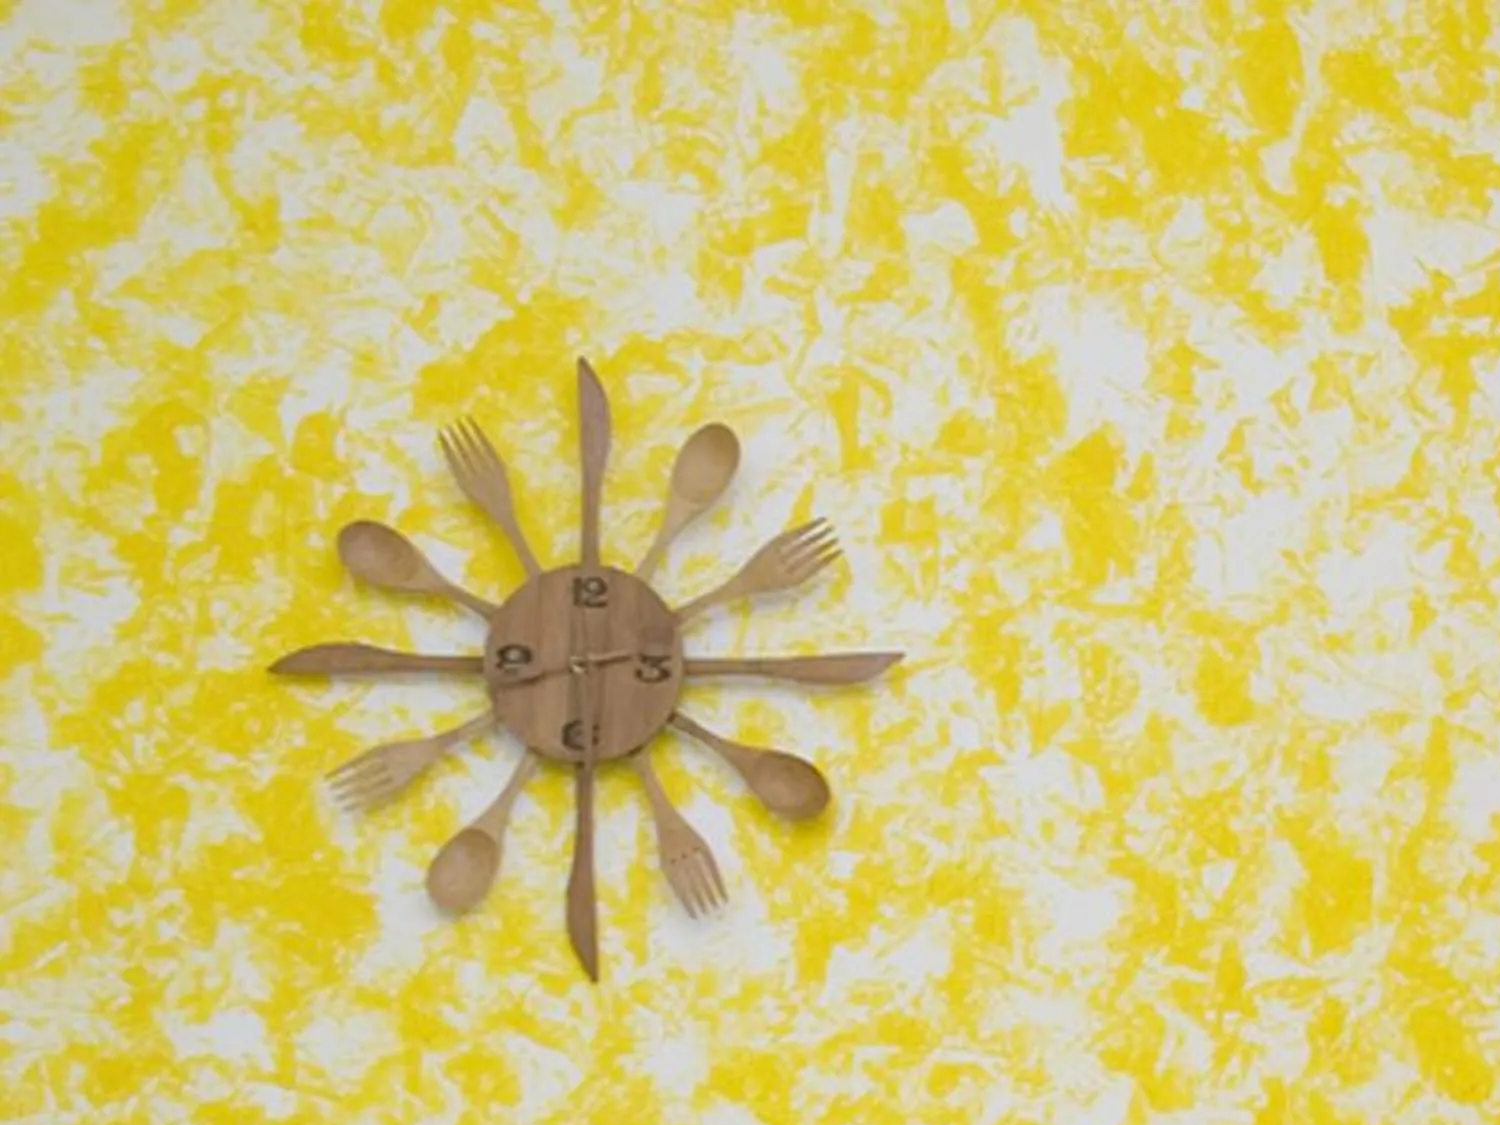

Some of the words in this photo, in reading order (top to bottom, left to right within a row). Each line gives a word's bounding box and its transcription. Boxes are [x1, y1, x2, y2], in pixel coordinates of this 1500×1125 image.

[573, 576, 608, 608] 12
[496, 644, 532, 674] 9
[634, 653, 672, 684] 3
